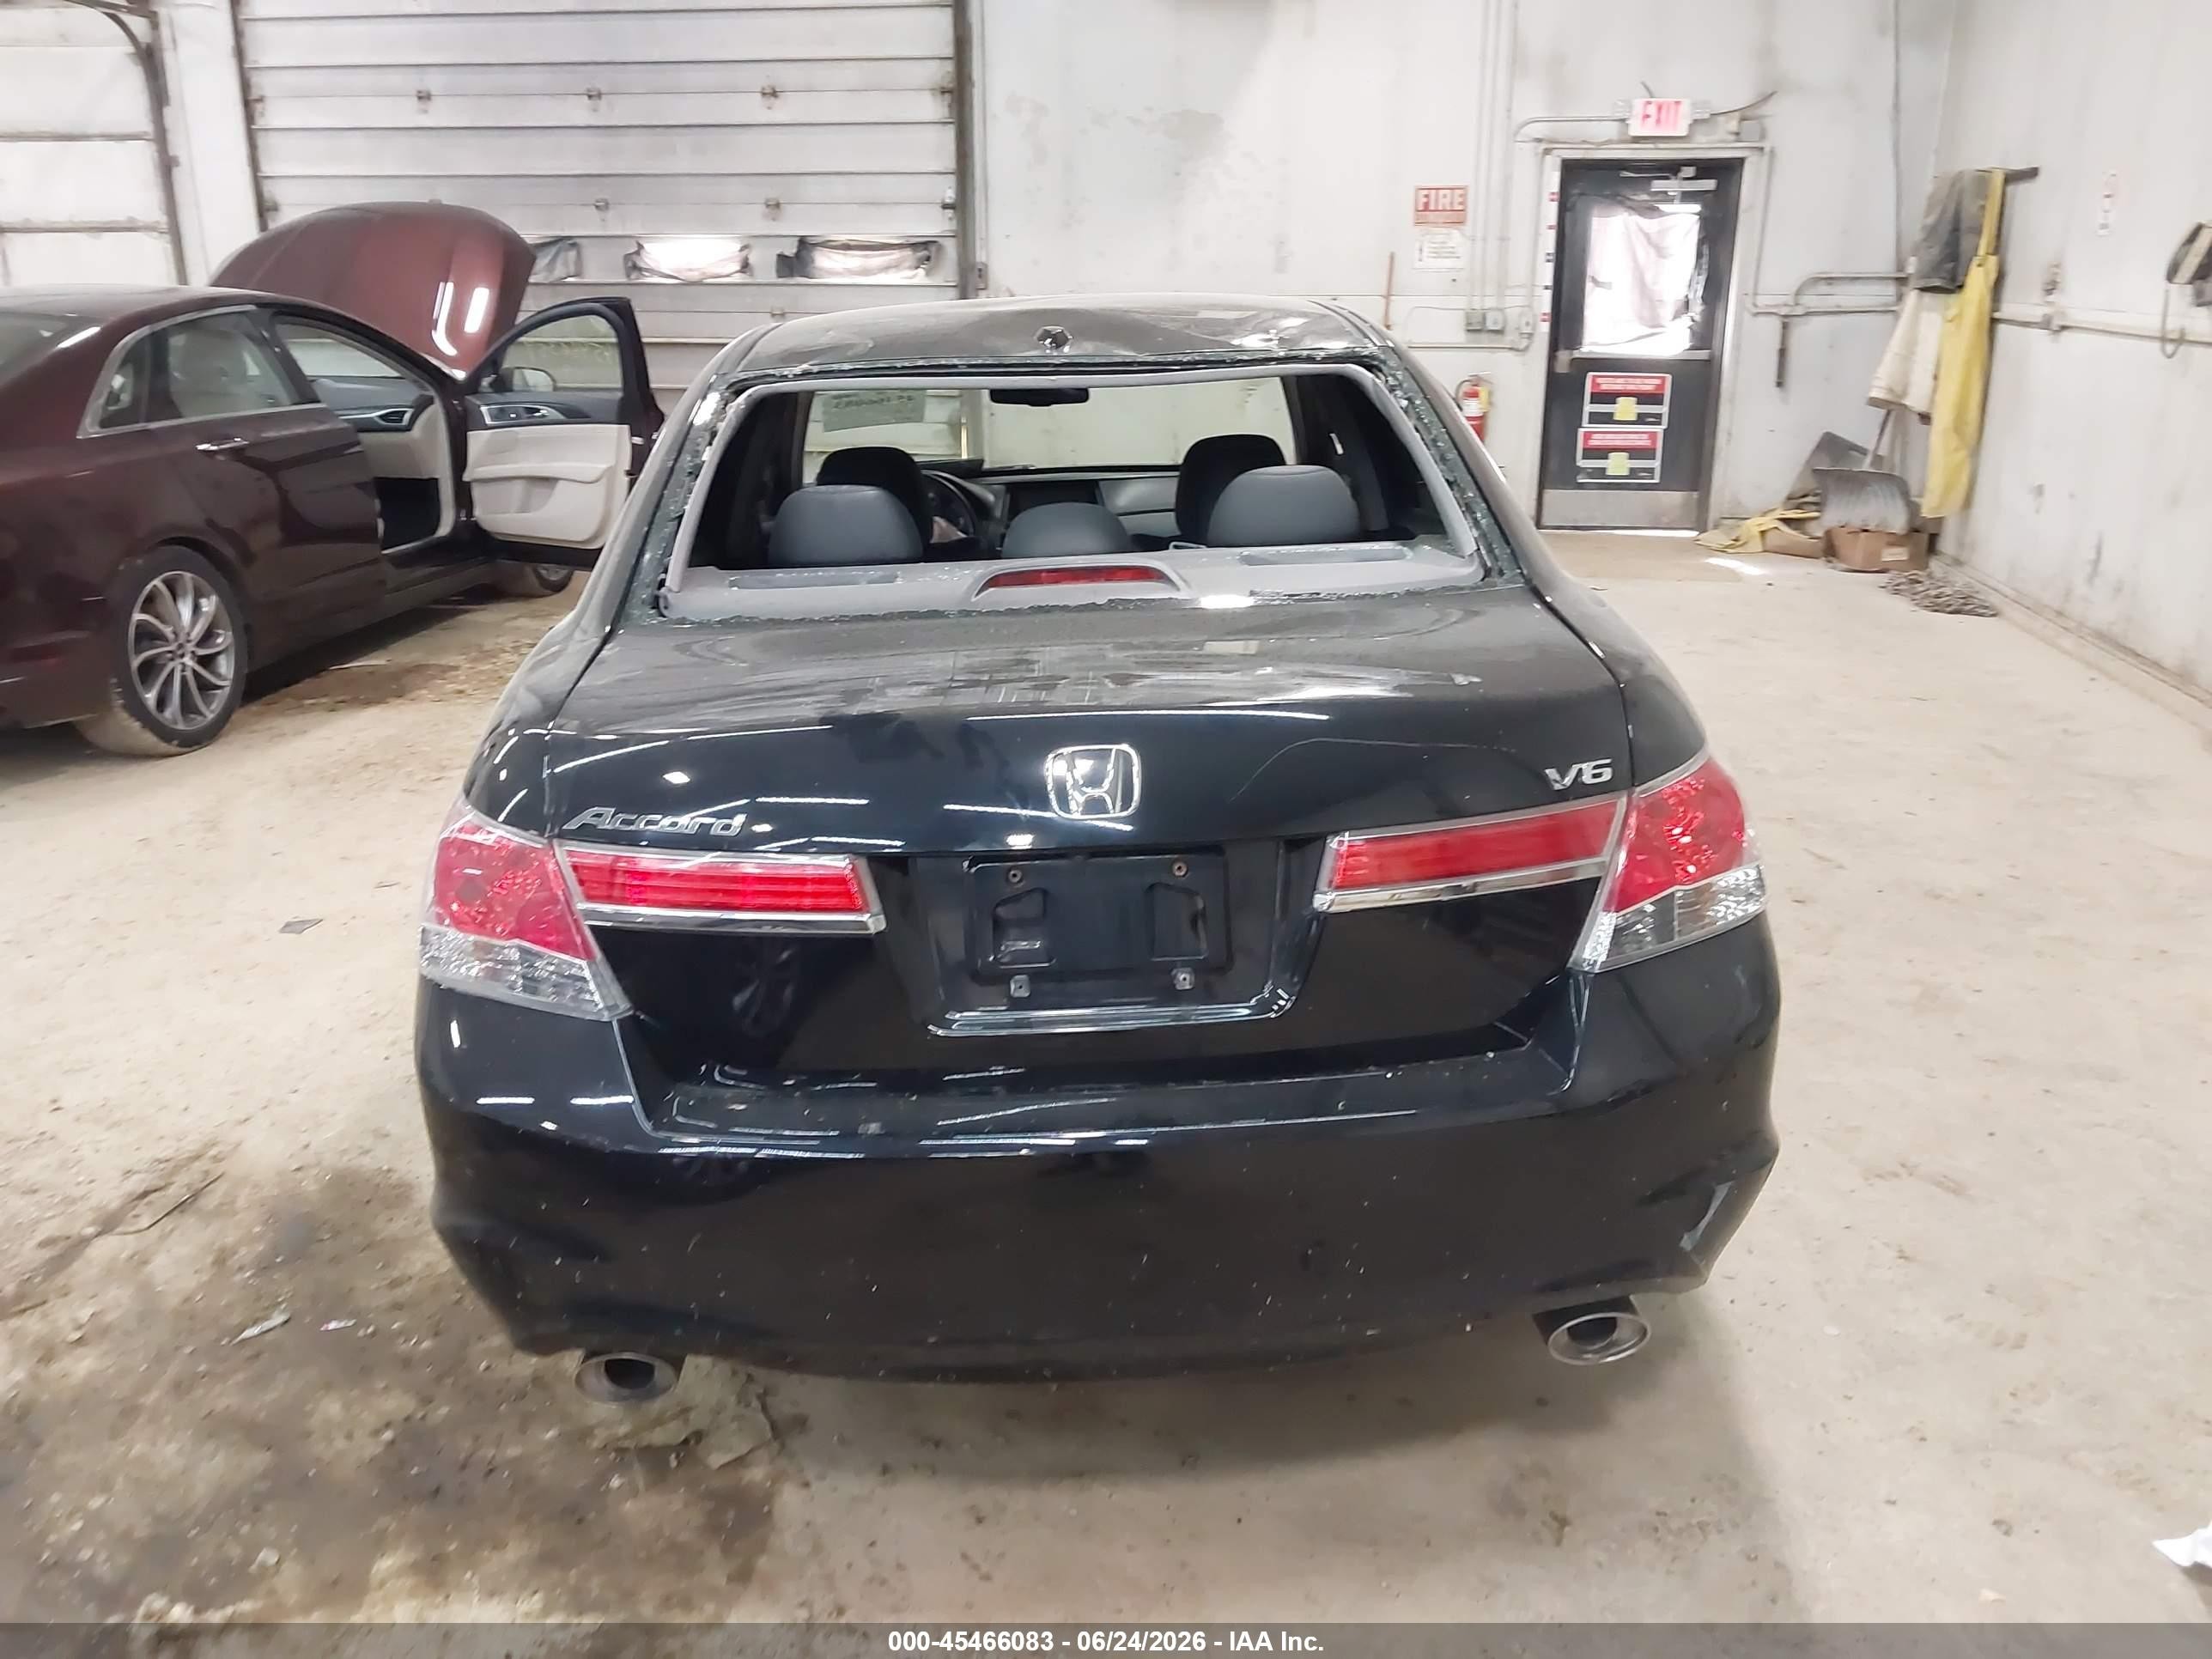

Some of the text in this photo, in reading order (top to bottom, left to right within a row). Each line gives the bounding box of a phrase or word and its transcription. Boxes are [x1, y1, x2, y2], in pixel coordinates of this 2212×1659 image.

[1640, 100, 1682, 132] EXIT
[1418, 189, 1465, 210] FIRE
[1544, 757, 1613, 791] V6
[562, 805, 748, 837] Accord
